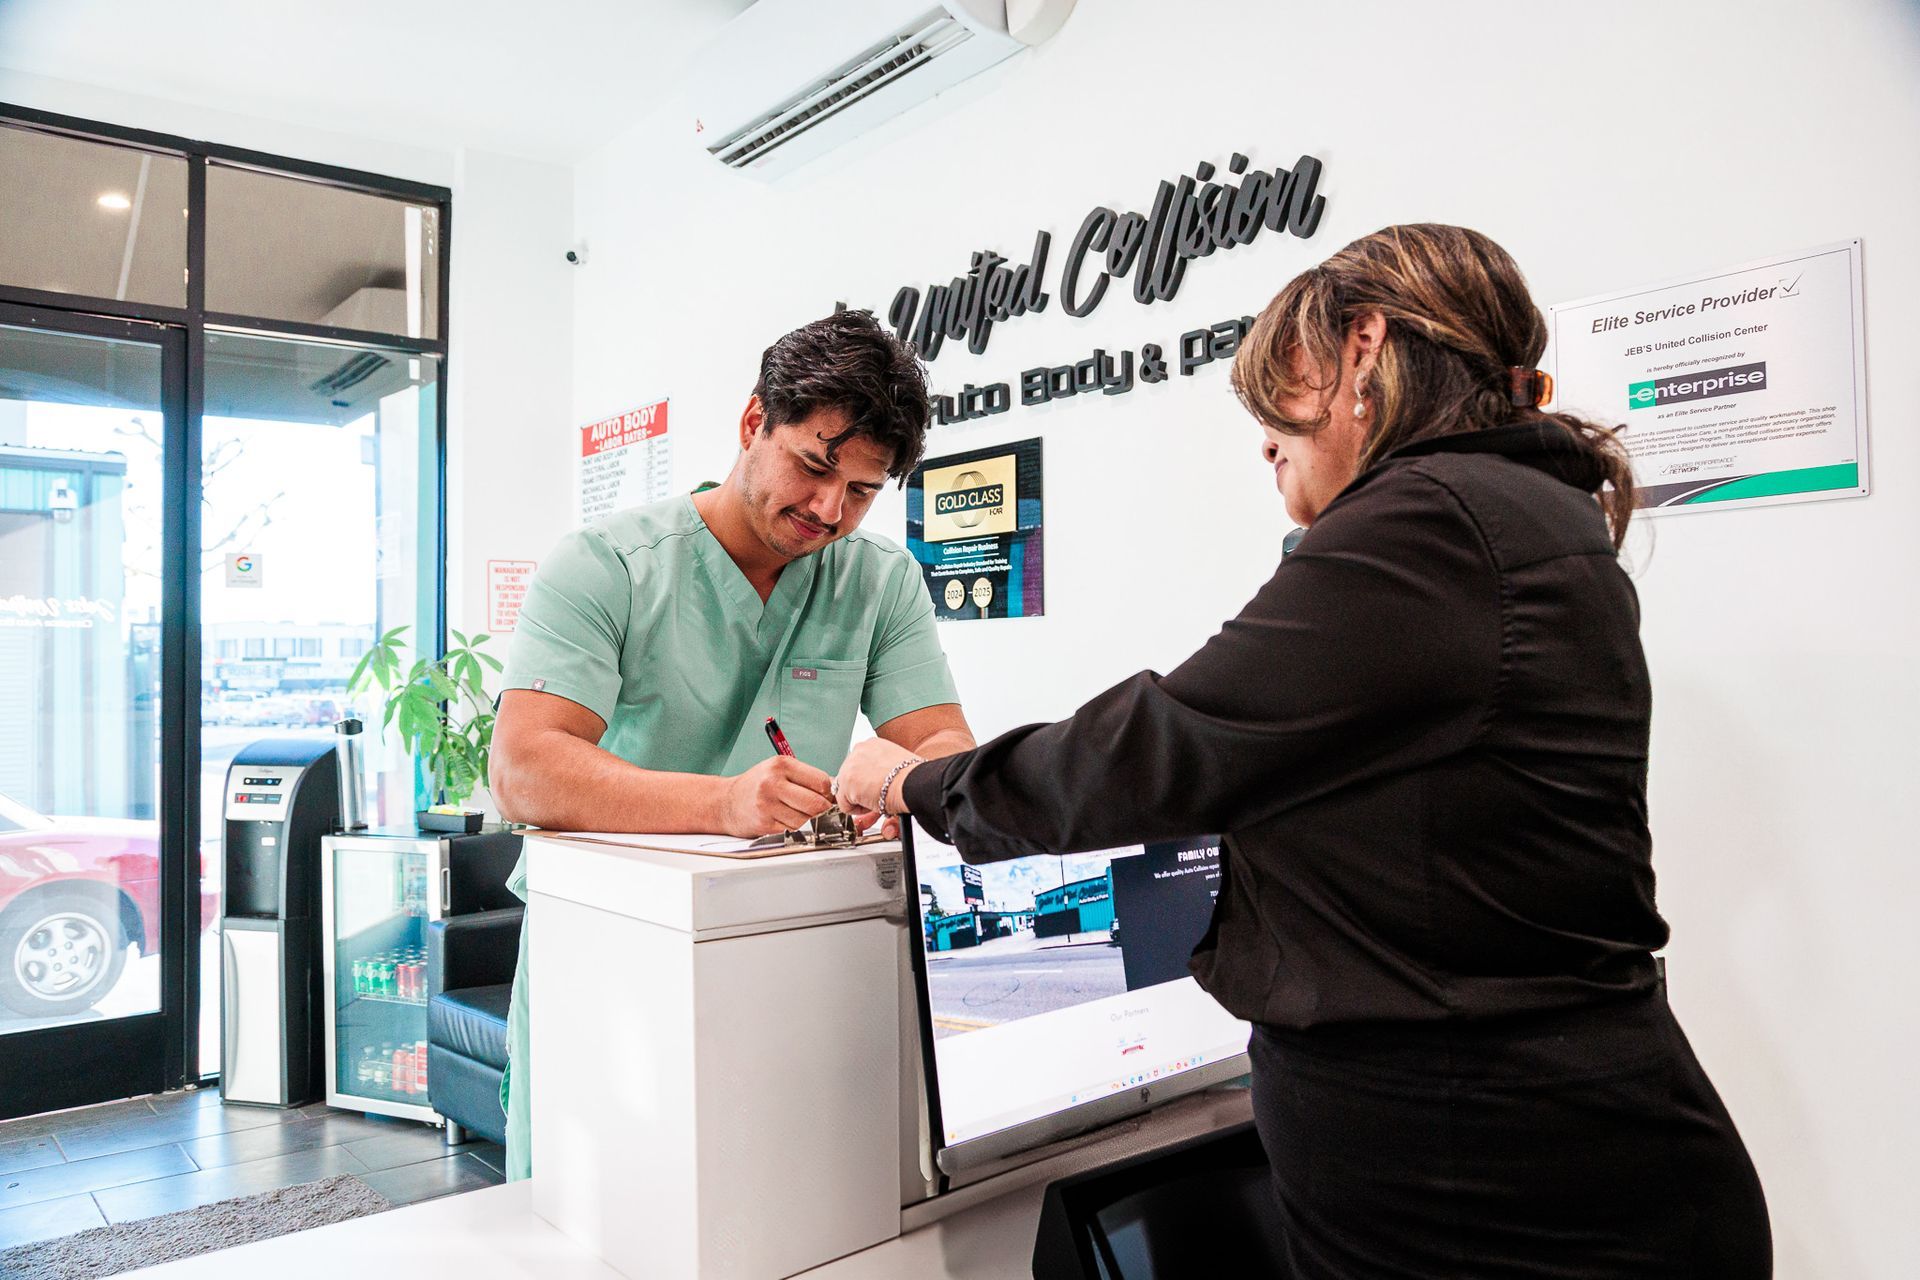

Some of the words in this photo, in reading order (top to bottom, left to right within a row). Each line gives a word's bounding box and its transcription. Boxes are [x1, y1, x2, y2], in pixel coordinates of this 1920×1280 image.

[889, 230, 1051, 361] United
[1060, 153, 1326, 317] Collision
[1591, 316, 1629, 334] Elite
[1634, 304, 1695, 325] Service
[1701, 286, 1777, 312] Provider
[1655, 338, 1685, 351] United
[1688, 330, 1731, 345] Collision
[1733, 324, 1768, 336] Center
[1021, 348, 1134, 406] Body
[1140, 343, 1169, 384] &
[1653, 364, 1674, 372] hereby
[1674, 359, 1701, 369] officially
[1701, 352, 1737, 363] recognized
[1636, 370, 1765, 402] enterprise
[1713, 403, 1737, 411] Partner
[590, 416, 622, 442] AUTO
[623, 405, 657, 432] BODY
[938, 494, 966, 511] GOLD
[968, 488, 1000, 506] CLASS
[943, 547, 962, 555] Collision
[977, 542, 999, 551] Business
[947, 590, 962, 600] 2024
[1177, 848, 1205, 862] FAMILY
